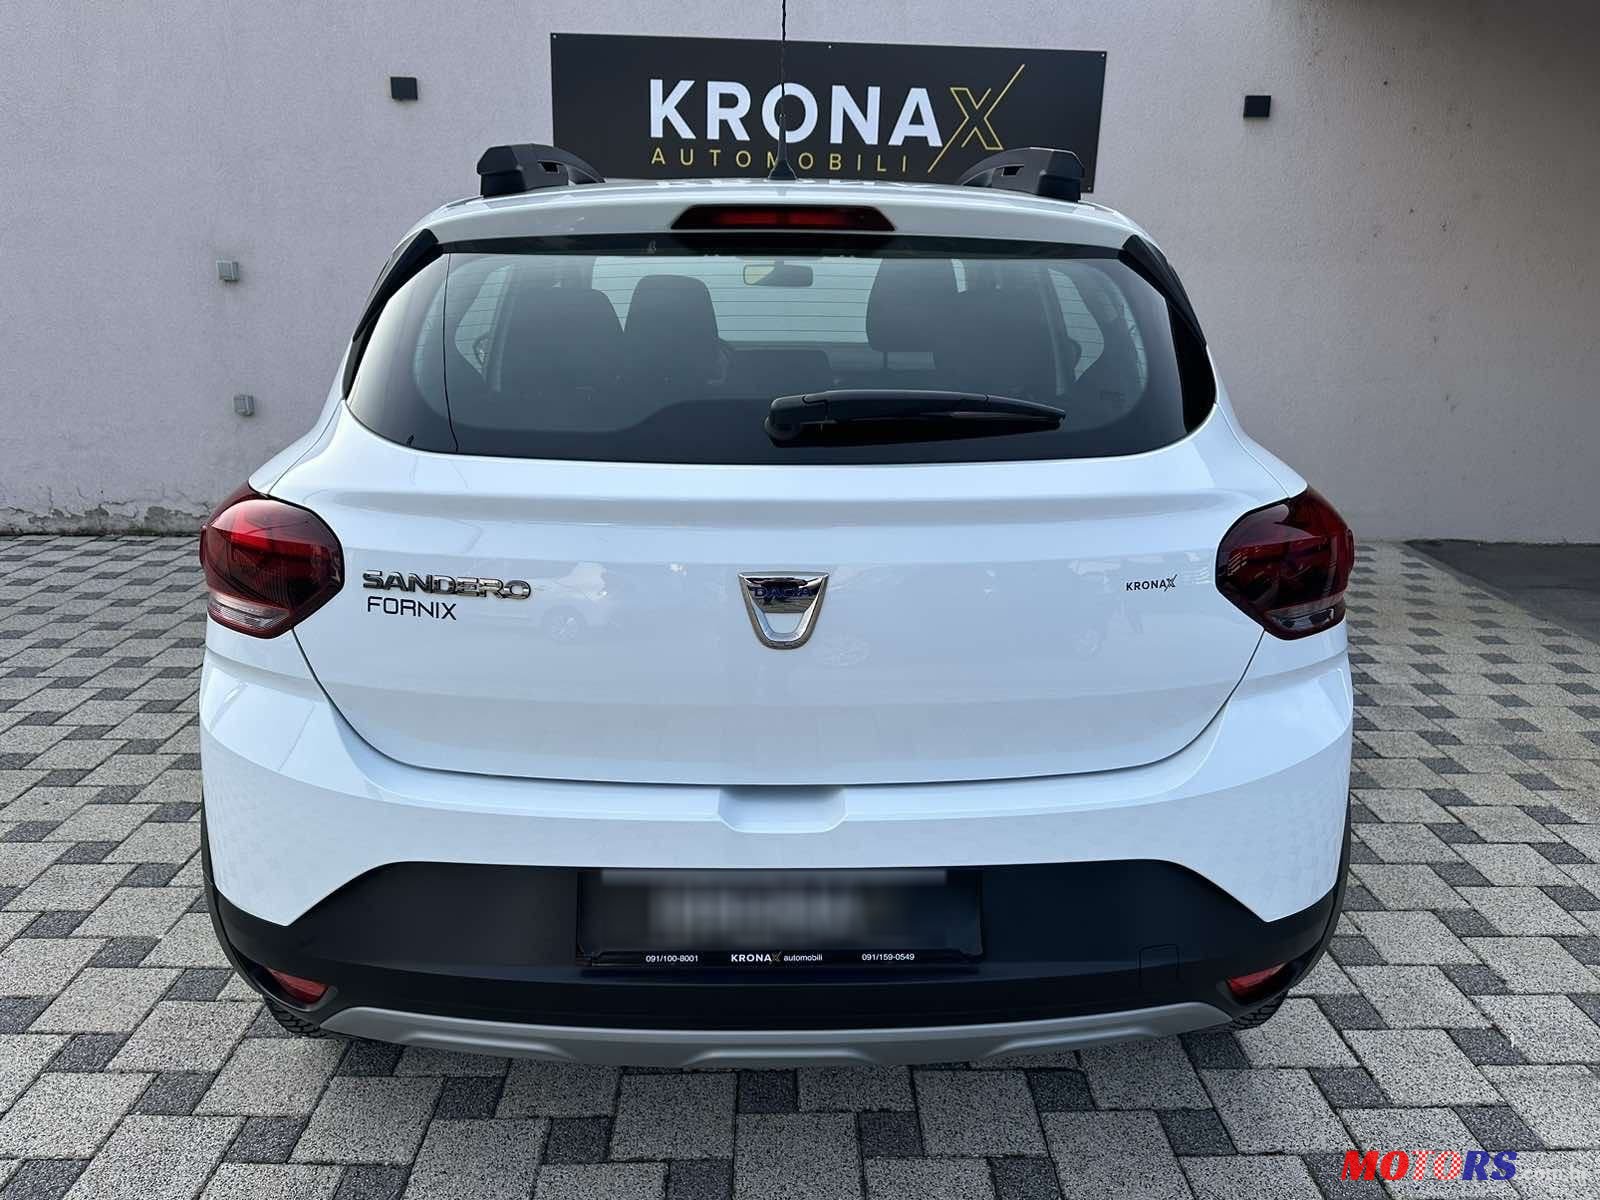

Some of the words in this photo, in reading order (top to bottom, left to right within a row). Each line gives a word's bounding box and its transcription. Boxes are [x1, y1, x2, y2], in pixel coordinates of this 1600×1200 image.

[649, 64, 1025, 173] KRONAX
[362, 569, 532, 600] SANDERO
[1126, 574, 1178, 592] KRONAX
[367, 596, 457, 621] FORNIX
[645, 954, 699, 963] 091/100-8001
[783, 953, 823, 962] automobili
[861, 953, 915, 961] 091/159-0549
